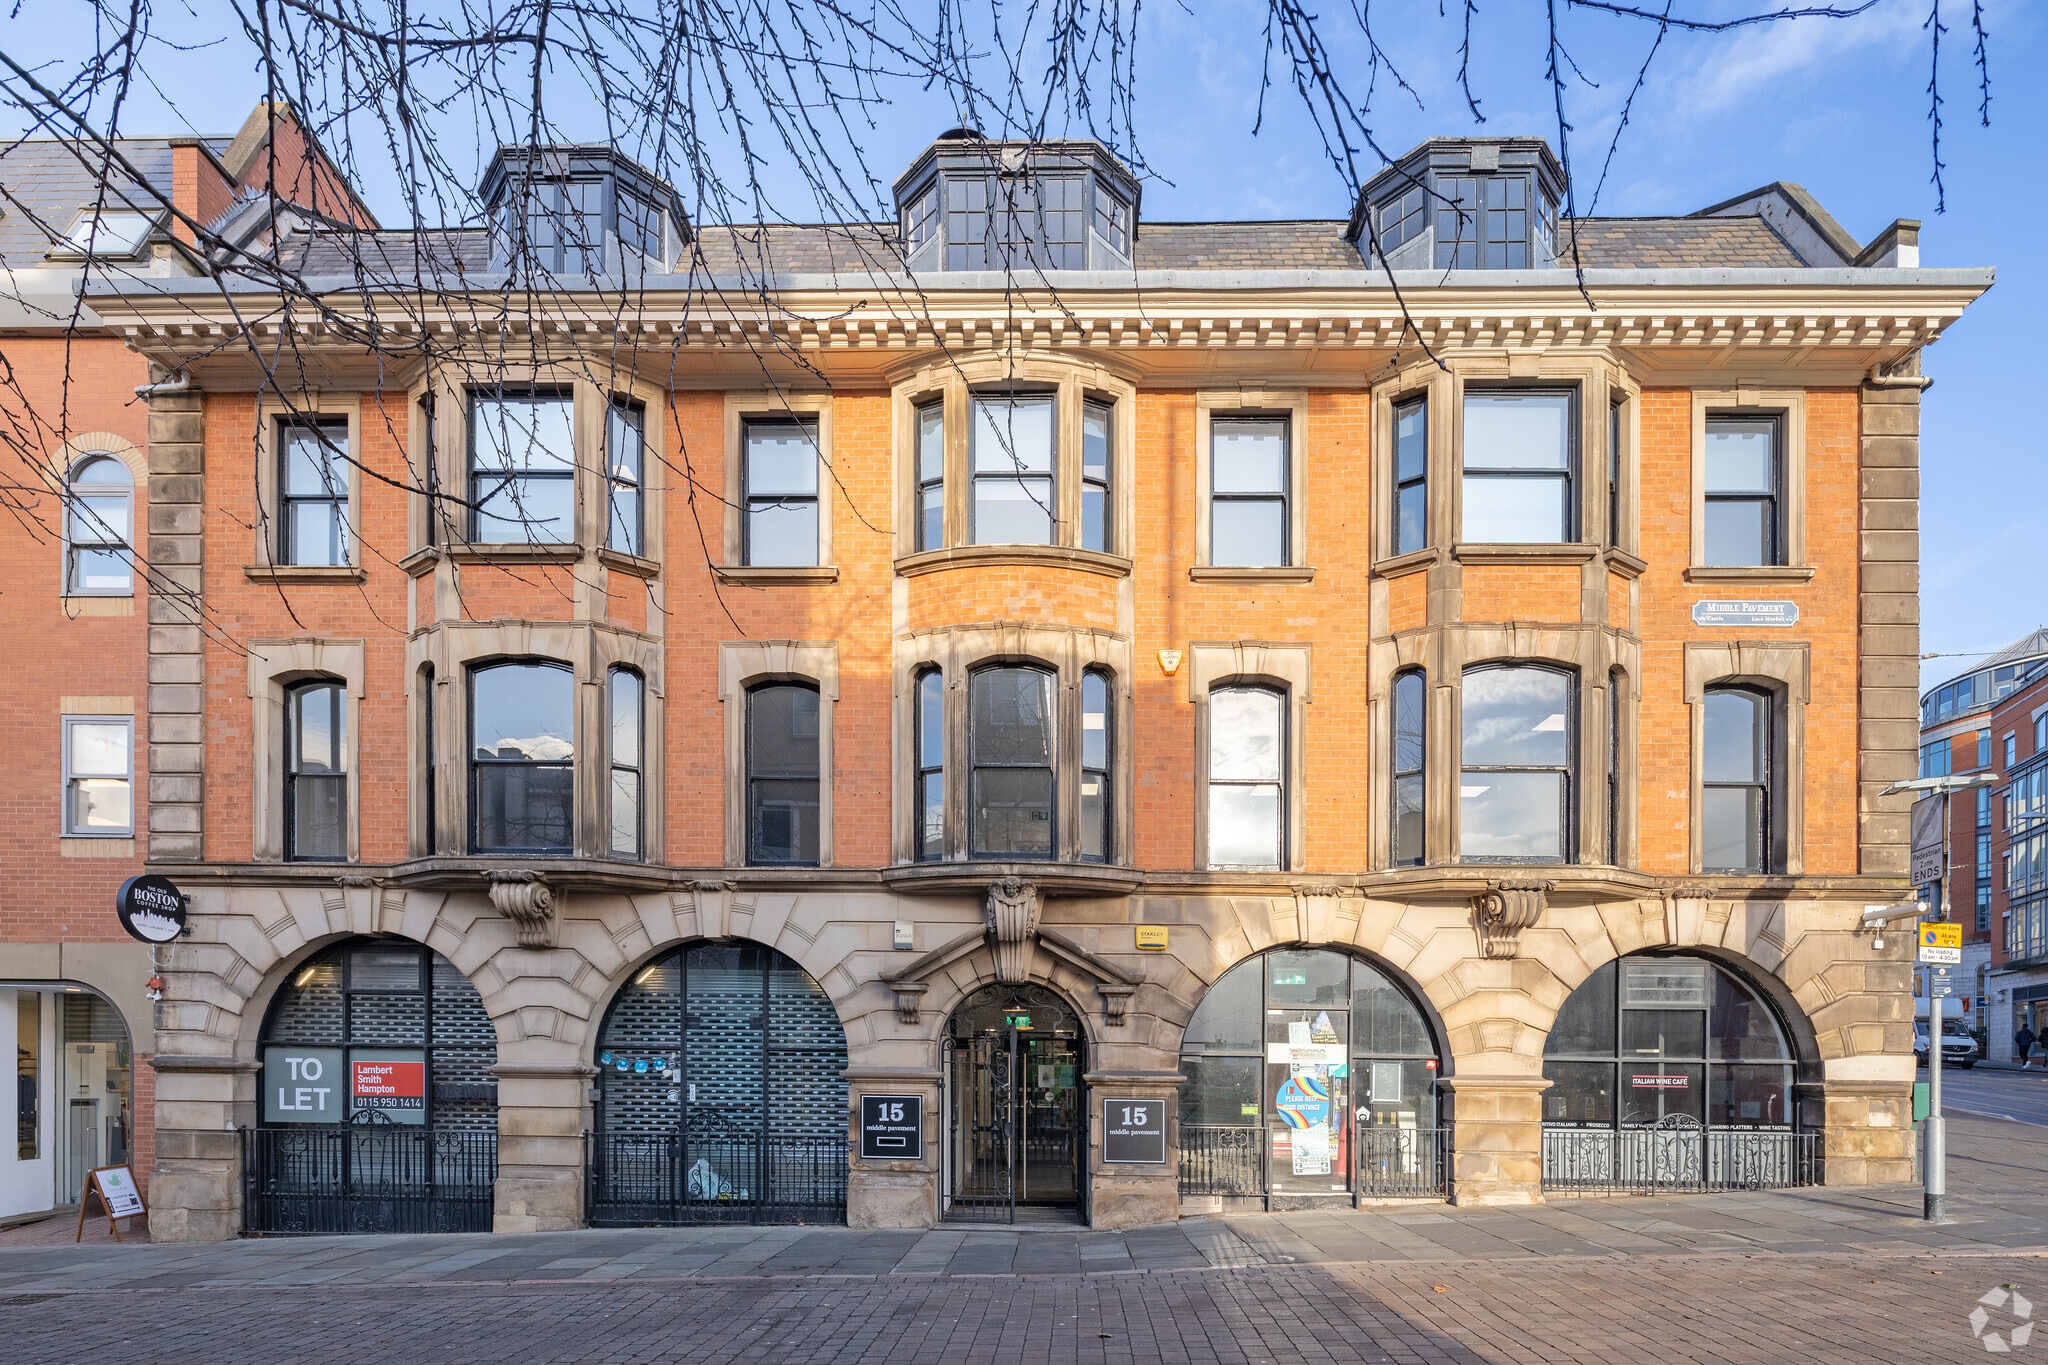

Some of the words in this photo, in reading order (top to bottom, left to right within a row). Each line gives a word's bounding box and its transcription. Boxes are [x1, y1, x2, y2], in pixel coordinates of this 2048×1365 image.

[1912, 847, 1942, 862] Pedestrian
[1920, 860, 1933, 869] Zone
[1914, 865, 1940, 882] ENDS
[134, 888, 179, 908] BOSTON
[136, 900, 159, 908] COFFEE
[285, 1057, 323, 1081] TO
[357, 1065, 393, 1075] Lambert
[357, 1074, 382, 1084] Smith
[357, 1084, 395, 1095] Hampton
[278, 1087, 331, 1111] LET
[357, 1097, 379, 1108] 0115
[380, 1097, 397, 1108] 950
[399, 1098, 421, 1108] 1414
[878, 1102, 905, 1122] 15
[1121, 1106, 1148, 1126] 15
[1130, 1129, 1160, 1137] pavement
